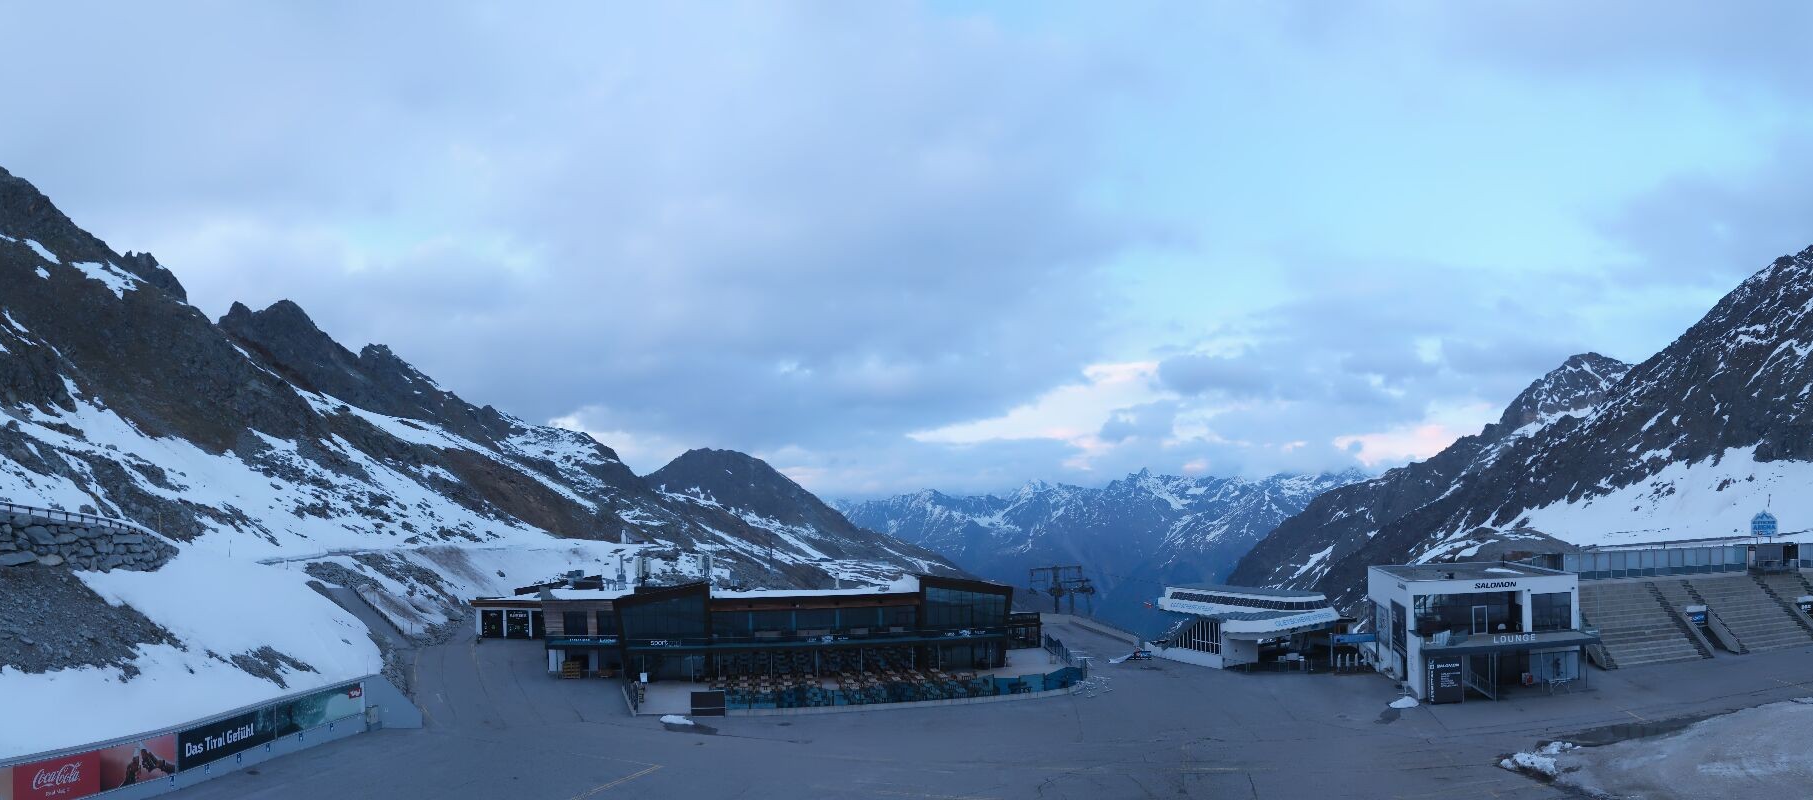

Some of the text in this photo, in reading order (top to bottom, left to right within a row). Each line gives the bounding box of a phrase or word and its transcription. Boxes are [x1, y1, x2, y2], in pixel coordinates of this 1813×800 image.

[1474, 581, 1517, 589] SALOMON
[1493, 634, 1536, 643] LOUNGE
[185, 723, 254, 757] Das Tirol Gefühl
